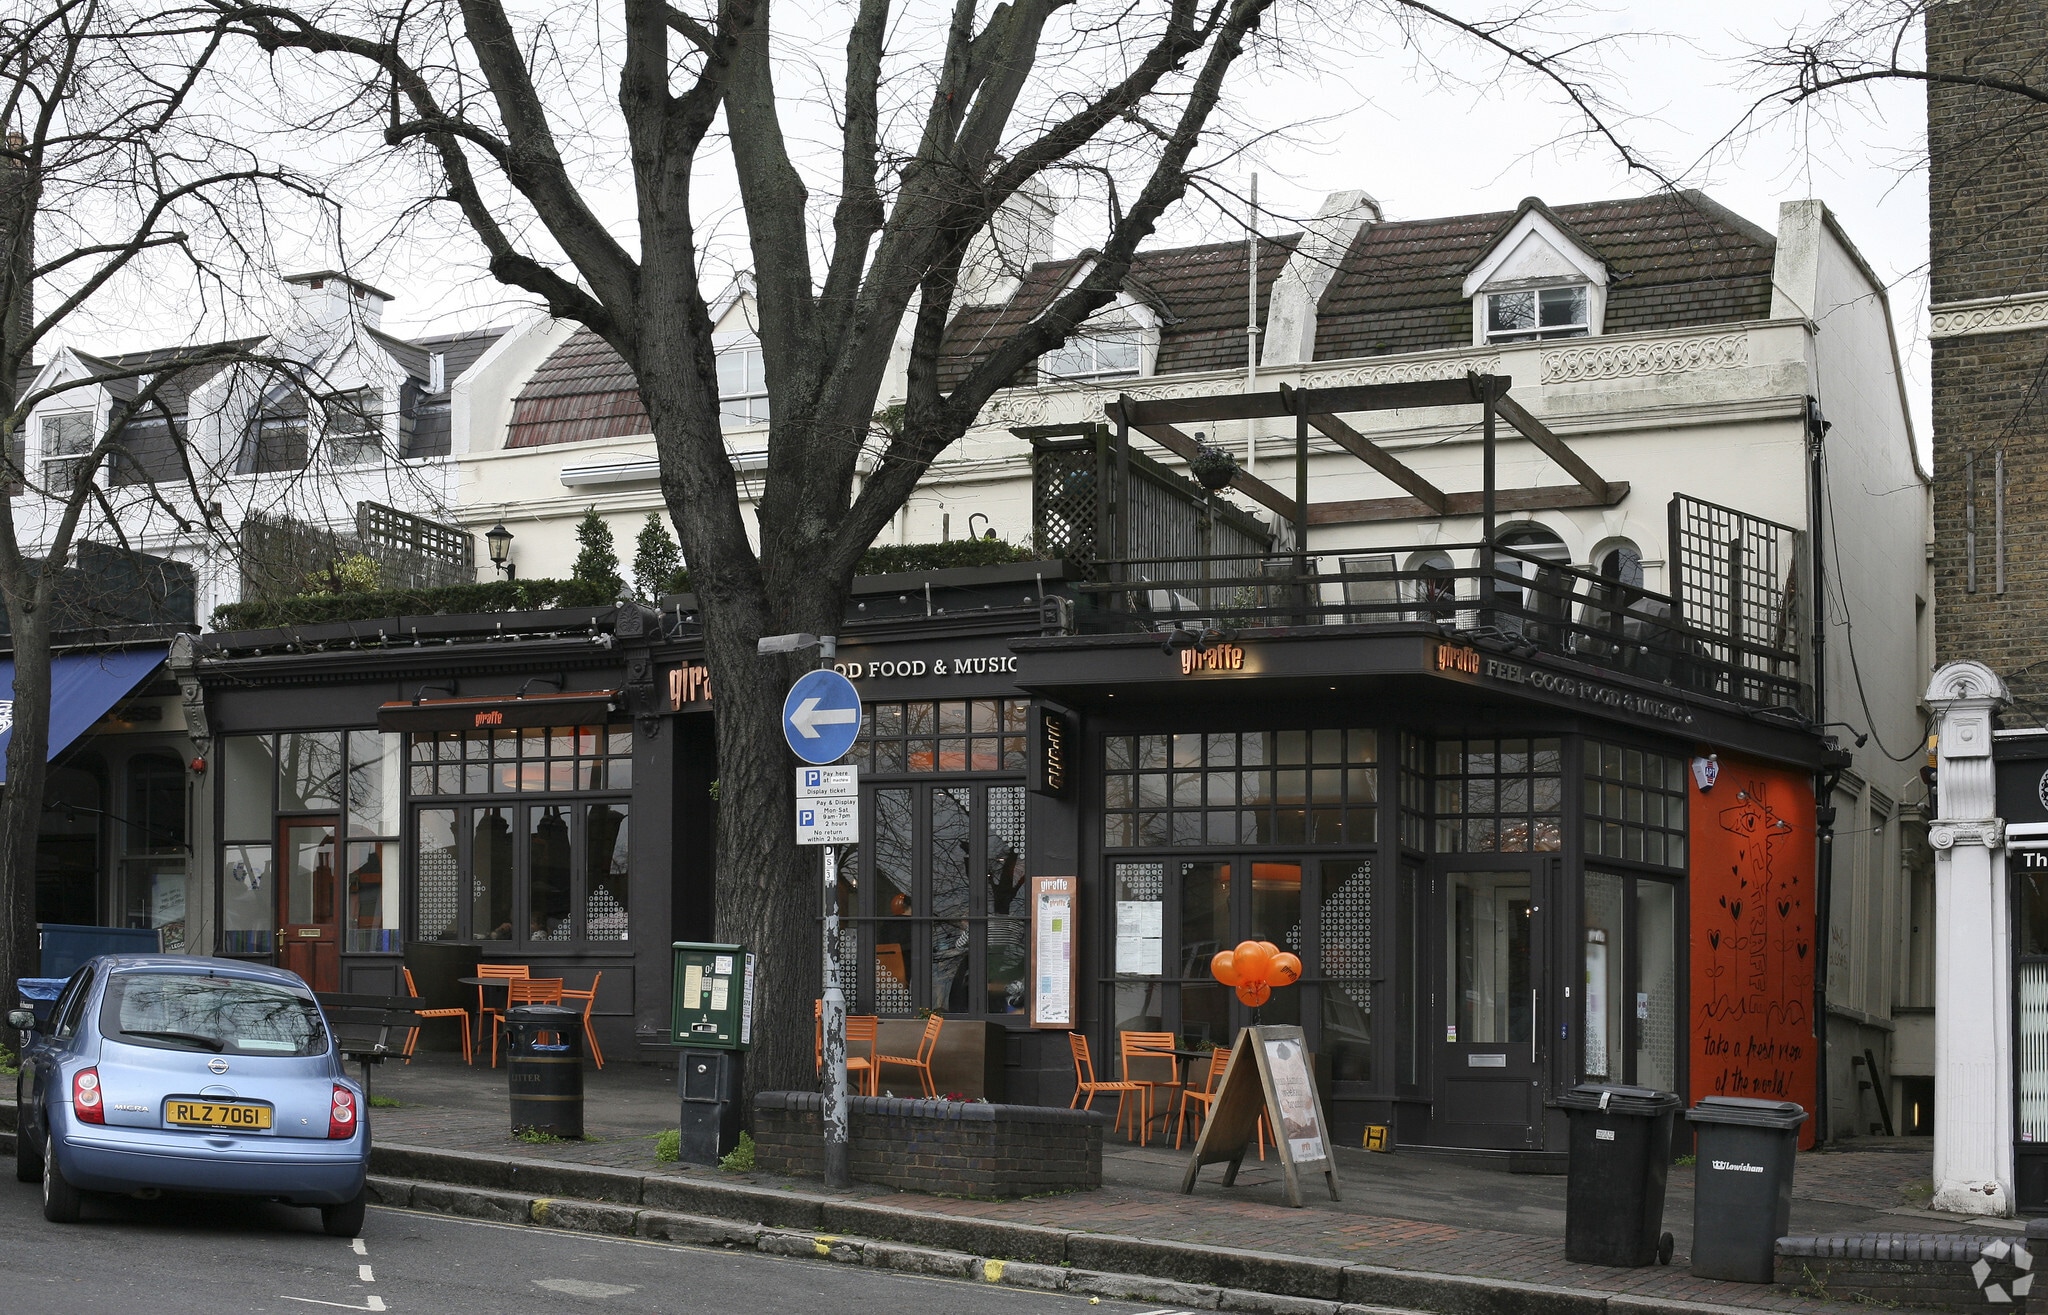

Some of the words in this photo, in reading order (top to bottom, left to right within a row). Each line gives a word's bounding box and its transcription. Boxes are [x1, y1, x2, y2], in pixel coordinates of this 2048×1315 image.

[869, 660, 927, 678] FOOD
[933, 659, 948, 675] &
[954, 656, 1017, 674] MUSIC
[1180, 643, 1243, 675] giraffe
[1438, 642, 1480, 674] giraffe
[1485, 658, 1576, 695] FEEL-GOOD
[1579, 682, 1620, 707] FOOD
[1636, 696, 1683, 722] MUSIC
[475, 710, 503, 727] giraffe
[1040, 878, 1068, 892] giraffe
[1704, 1028, 1729, 1056] take
[1733, 1041, 1741, 1057] a
[1715, 1068, 1728, 1097] of
[1731, 1066, 1749, 1093] the
[113, 1103, 150, 1113] MICRA
[177, 1104, 214, 1122] RLZ
[218, 1106, 259, 1125] 7061
